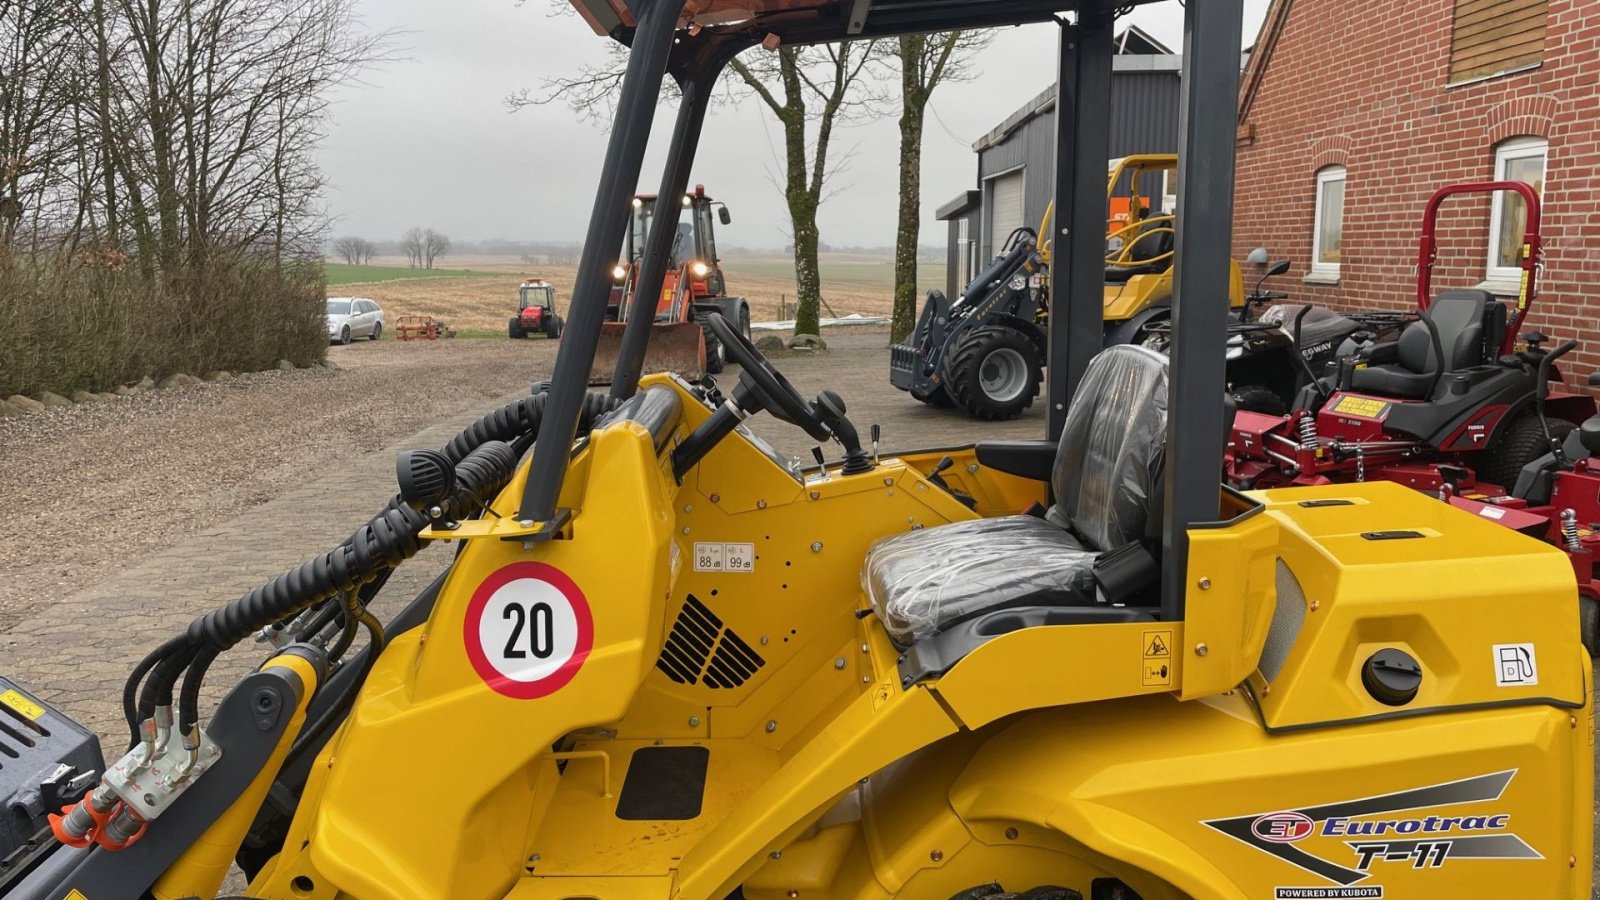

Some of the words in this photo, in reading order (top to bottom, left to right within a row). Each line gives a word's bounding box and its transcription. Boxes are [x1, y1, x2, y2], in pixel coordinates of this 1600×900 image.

[1301, 341, 1332, 360] EGWAY
[699, 556, 712, 568] 88
[713, 560, 721, 568] dB
[730, 557, 742, 568] 99
[503, 602, 554, 659] 20
[1320, 813, 1510, 837] Eurotrac
[1355, 841, 1453, 870] T-11
[1279, 889, 1326, 898] POWERED
[1327, 889, 1340, 897] BY
[1341, 888, 1378, 897] KUBOTA
